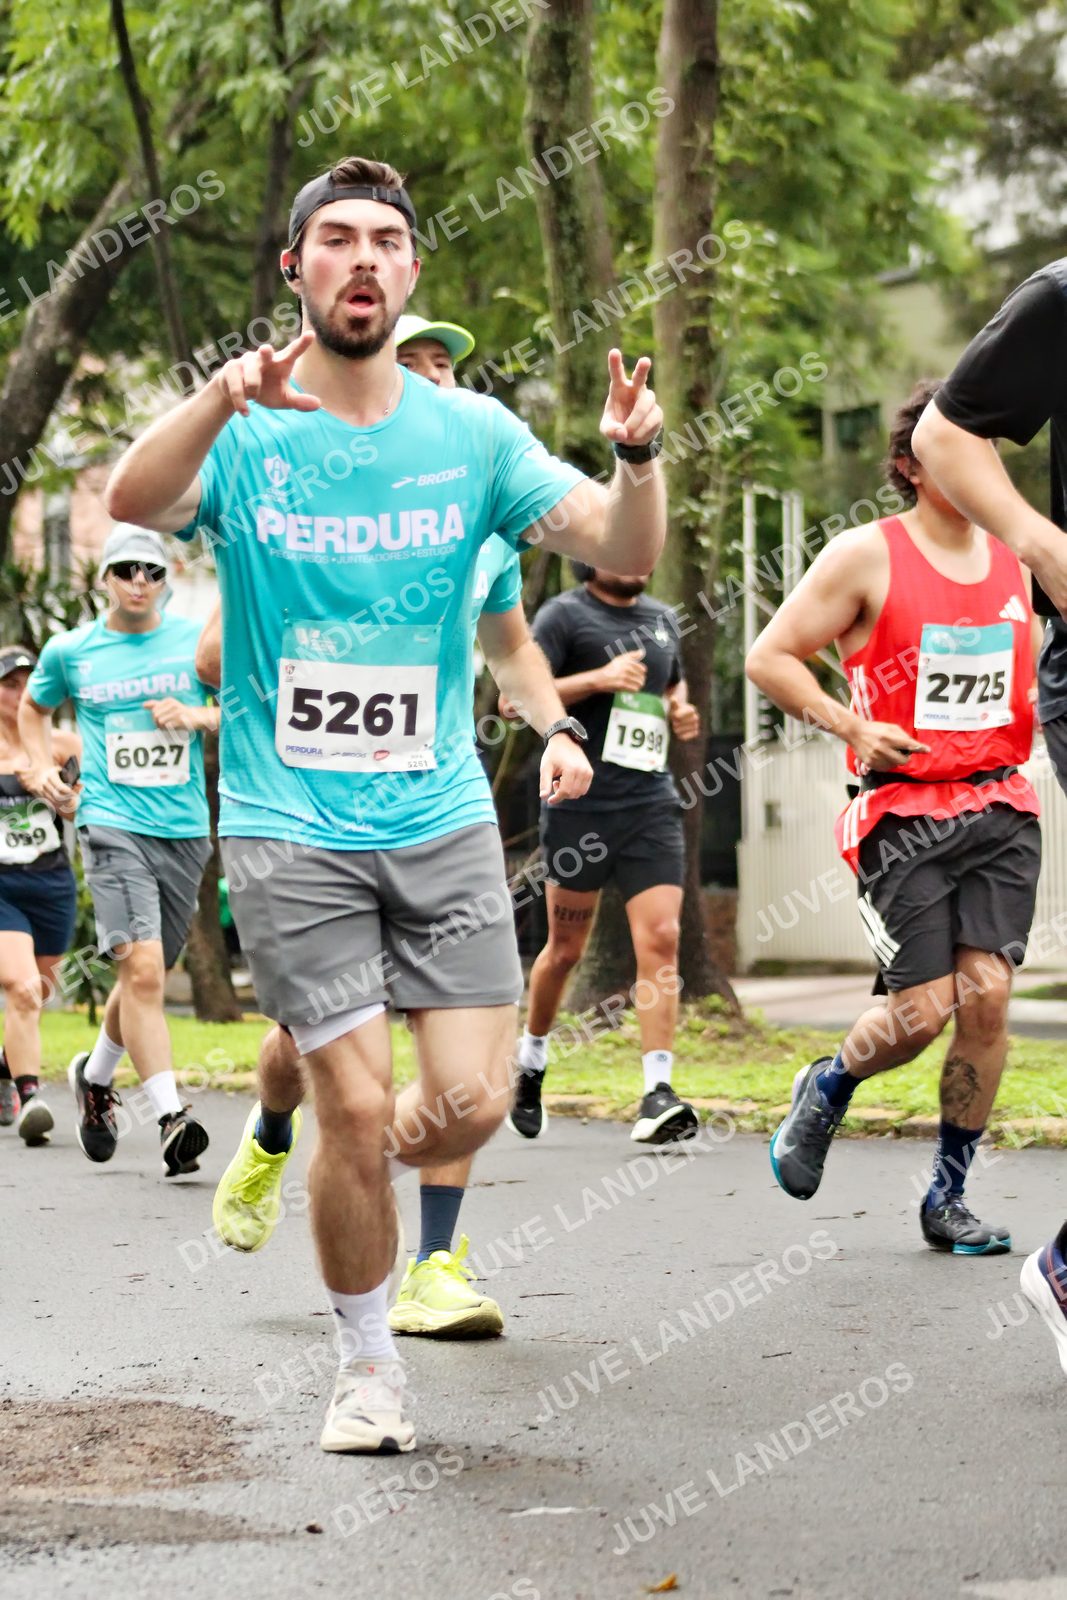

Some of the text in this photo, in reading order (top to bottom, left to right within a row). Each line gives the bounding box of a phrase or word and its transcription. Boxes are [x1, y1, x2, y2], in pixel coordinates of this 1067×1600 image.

[417, 464, 468, 487] BROOKS
[256, 503, 465, 554] PERDURA
[337, 550, 410, 564] JUNTEADORES
[77, 671, 192, 704] PERDURA
[926, 671, 1005, 704] 2725
[288, 687, 418, 737] 5261
[114, 745, 184, 769] 6027
[286, 745, 323, 756] PERDURA
